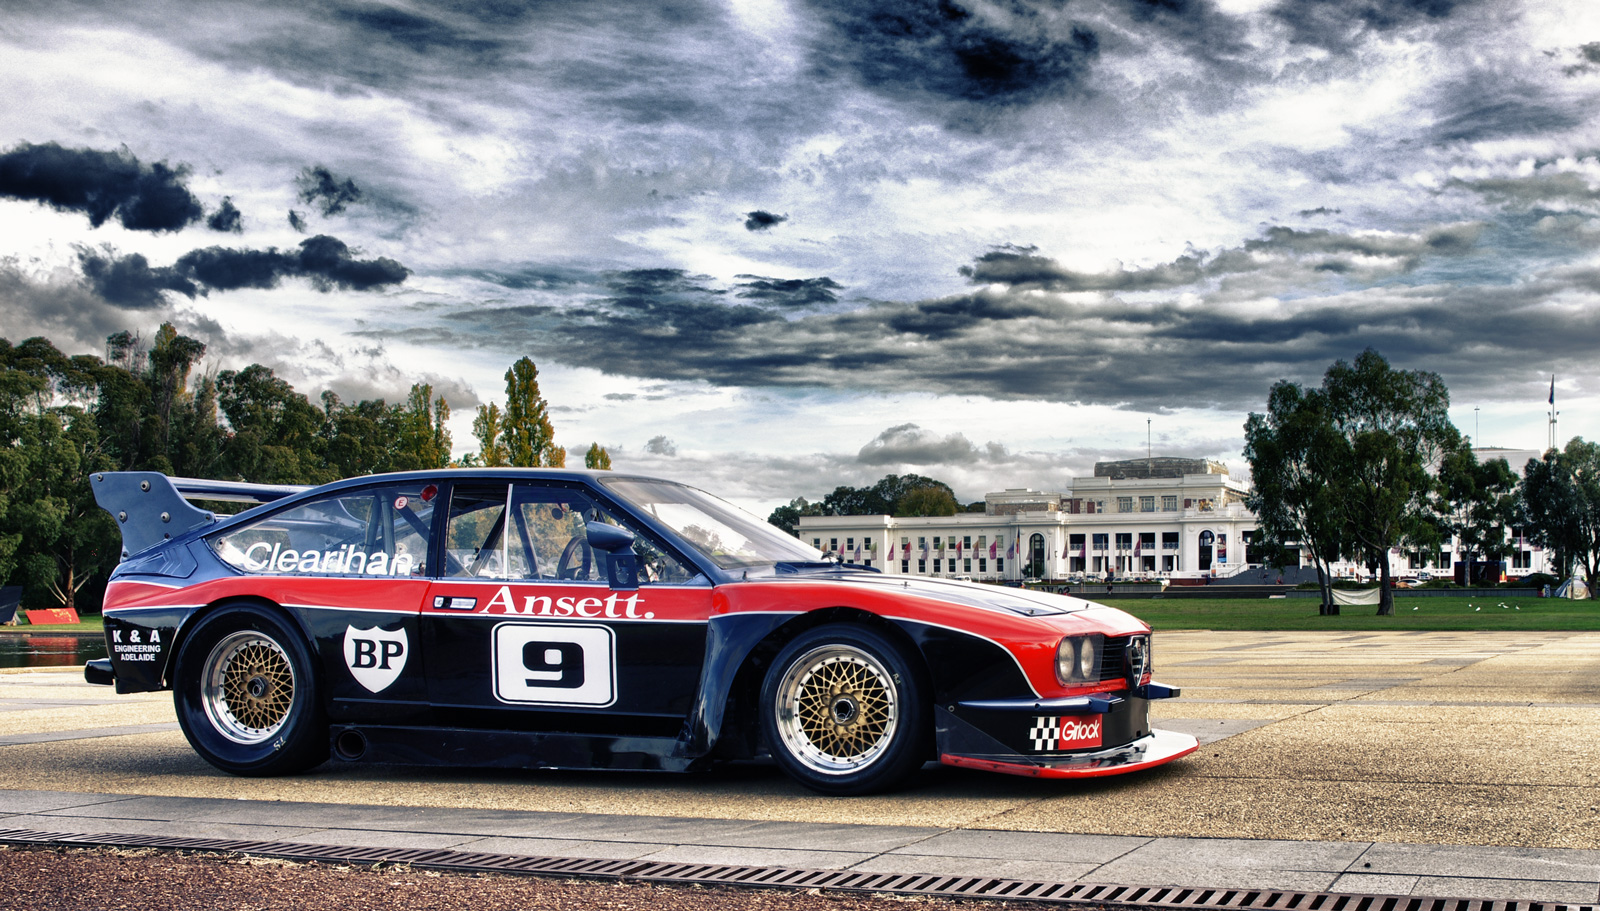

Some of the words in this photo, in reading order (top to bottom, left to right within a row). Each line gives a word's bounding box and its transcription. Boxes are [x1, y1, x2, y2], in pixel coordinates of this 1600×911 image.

[398, 499, 405, 507] E
[244, 542, 413, 576] Clearihan
[112, 629, 122, 643] K
[129, 629, 141, 643] &
[149, 629, 161, 643] A
[114, 644, 161, 653] ENGINEERING
[351, 638, 404, 670] BP
[120, 653, 156, 661] ADELAIDE
[522, 641, 585, 689] 9
